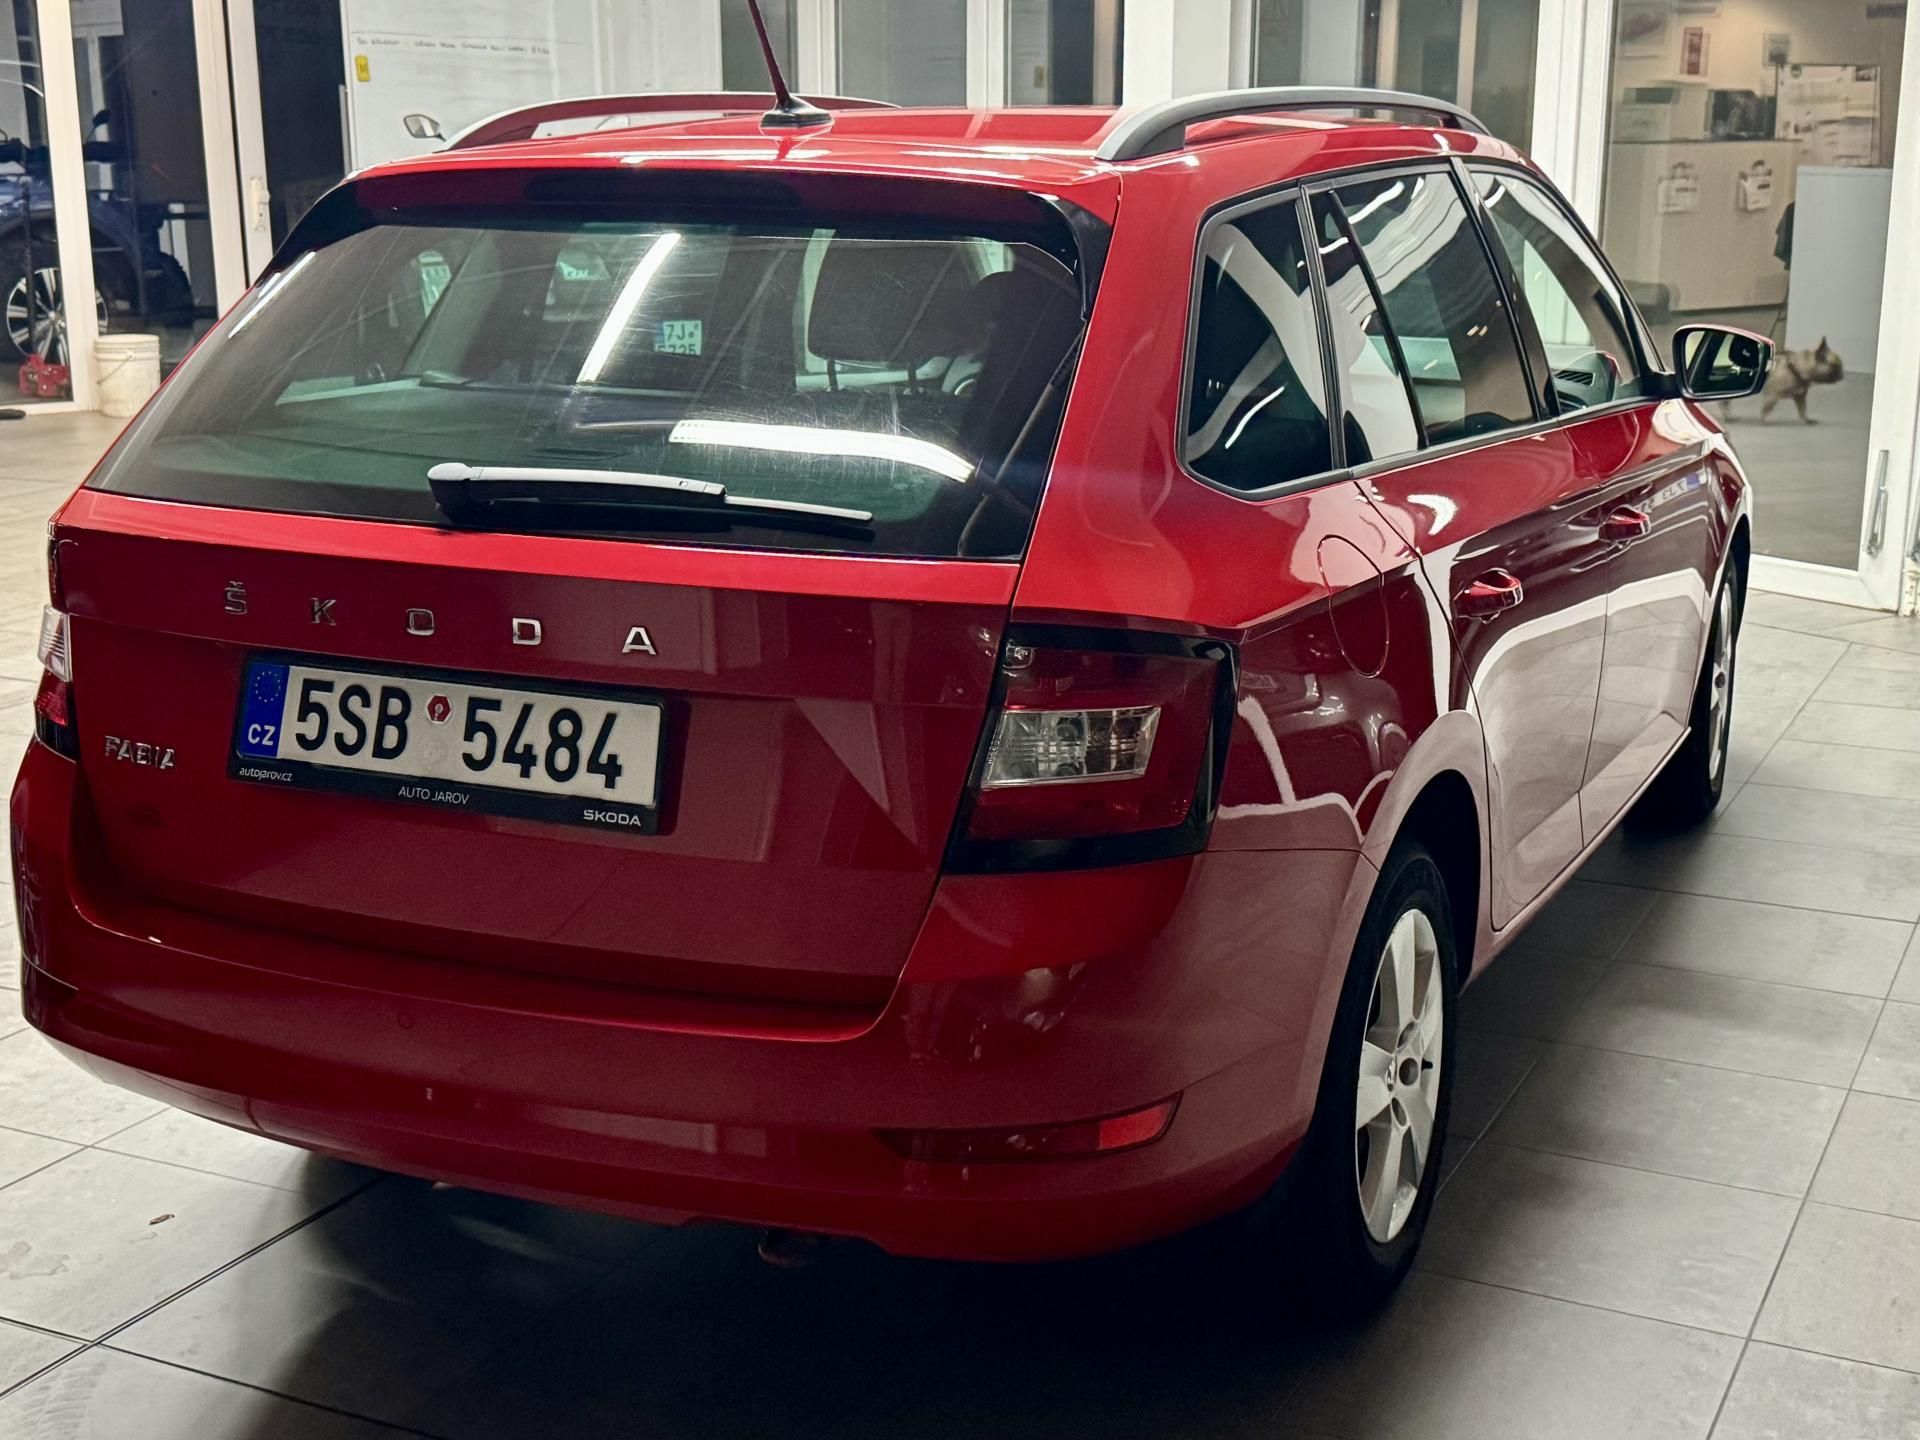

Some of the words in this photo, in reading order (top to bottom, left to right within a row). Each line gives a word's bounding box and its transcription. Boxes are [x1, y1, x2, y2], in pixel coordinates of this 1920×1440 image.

[224, 581, 657, 655] ŠKODA
[247, 724, 276, 746] CZ
[295, 678, 412, 759] 5SB
[462, 697, 623, 789] 5484
[105, 736, 174, 769] FABIA
[239, 767, 292, 781] autojarov.cz
[399, 786, 430, 800] AUTO
[432, 790, 469, 805] JAROV
